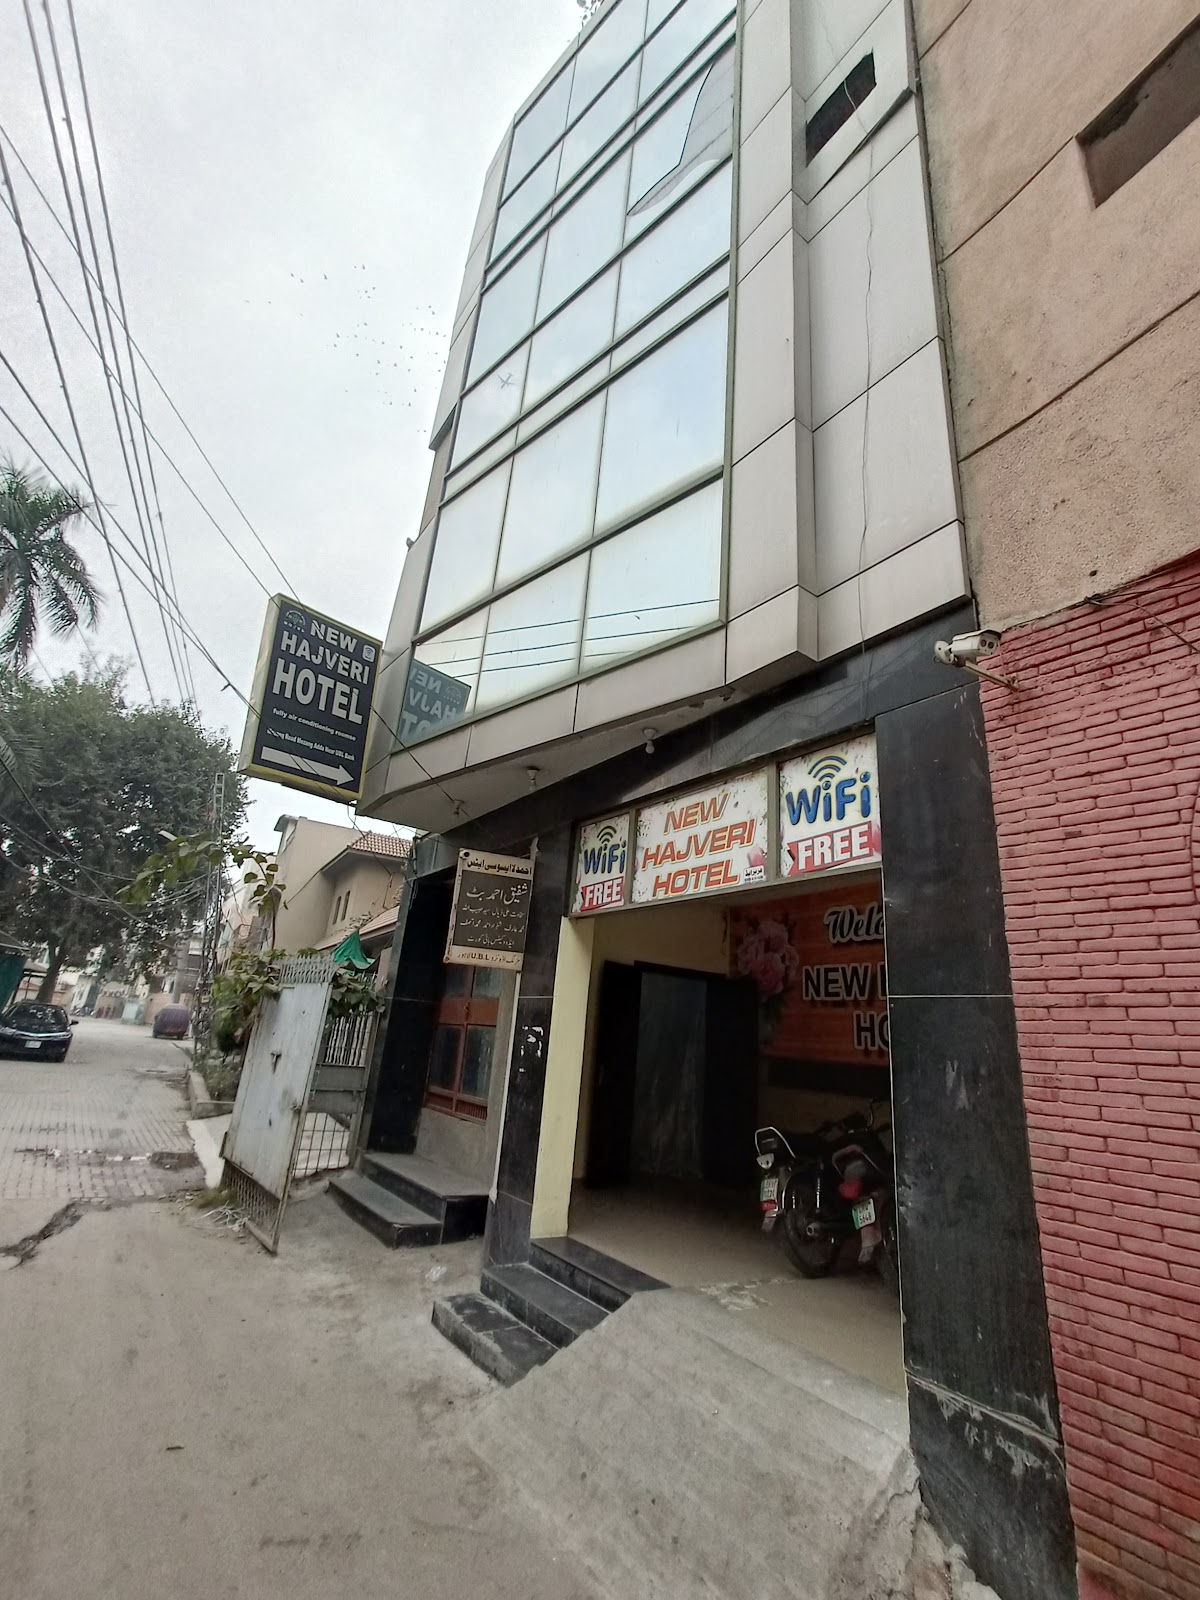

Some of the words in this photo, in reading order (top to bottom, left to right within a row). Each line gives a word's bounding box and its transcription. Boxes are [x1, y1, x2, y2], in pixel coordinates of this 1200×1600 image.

[310, 619, 358, 653] NEW
[281, 630, 370, 685] HAJVERI
[272, 657, 363, 725] HOTEL
[272, 707, 288, 719] fully
[288, 710, 298, 721] air
[298, 715, 335, 735] conditioning
[663, 791, 731, 835] NEW
[785, 771, 871, 825] WiFi
[583, 840, 626, 874] WiFi
[641, 818, 757, 871] HAJVERI
[797, 823, 870, 871] FREE
[516, 865, 532, 875] احمد
[652, 859, 740, 899] HOTEL
[466, 886, 486, 901] بٹ
[486, 889, 504, 900] احمد
[503, 883, 528, 905] شفیق
[585, 877, 623, 908] FREE
[802, 962, 872, 1001] NEW
